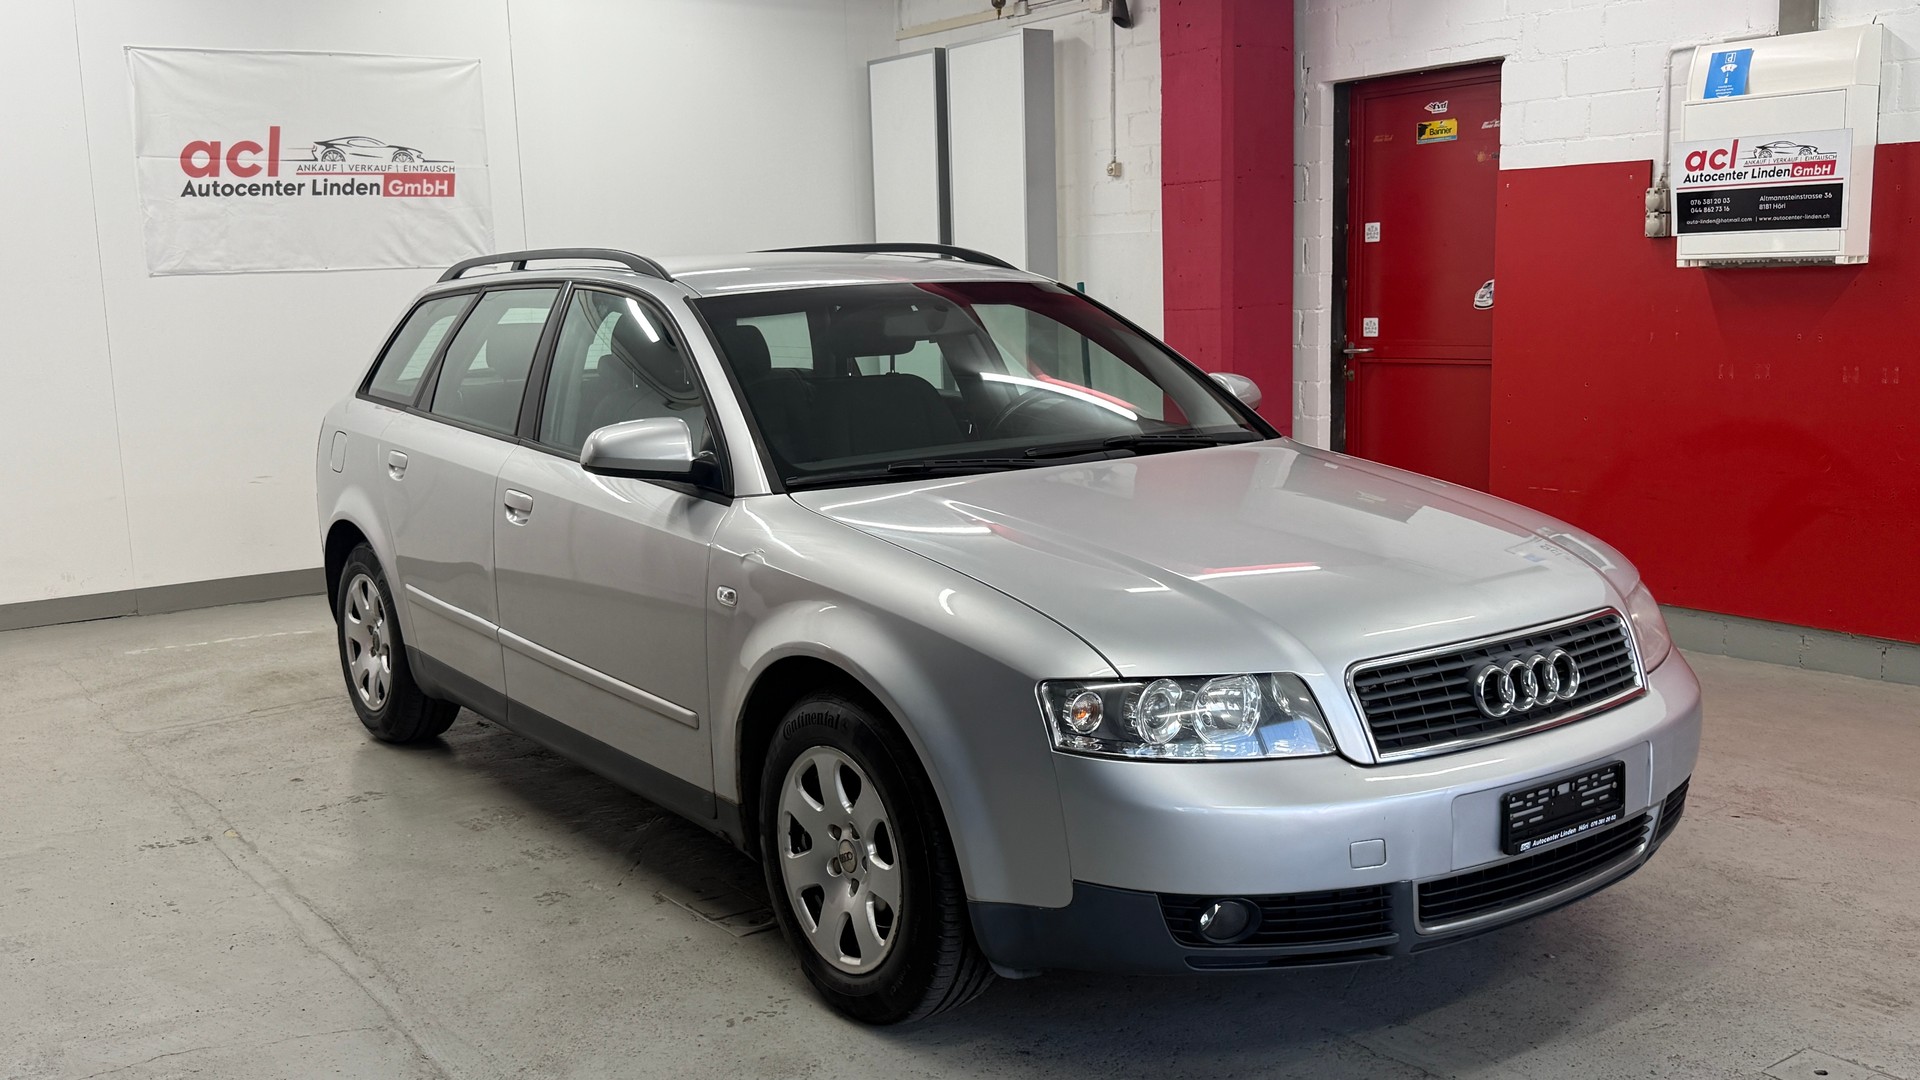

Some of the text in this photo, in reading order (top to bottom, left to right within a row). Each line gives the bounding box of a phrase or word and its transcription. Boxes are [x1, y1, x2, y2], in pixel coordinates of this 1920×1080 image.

[1429, 127, 1453, 136] Banner
[179, 126, 281, 178] acl
[1685, 139, 1739, 172] acl
[1804, 154, 1838, 162] EINTAUSCH
[296, 164, 456, 173] ANKAUF VERKAUF EINTAUSCH
[1683, 164, 1832, 184] Autocenter Linden GmbH
[180, 178, 449, 198] Autocenter Linden GmbH
[1759, 192, 1823, 202] Altmannsteinstrasse
[1686, 217, 1753, 225] auto-linden@hotmail.com
[1758, 213, 1831, 222] www.autocenter-linden.ch
[783, 710, 841, 740] Continental
[1532, 833, 1560, 847] Autocenter
[1560, 827, 1577, 838] Linden
